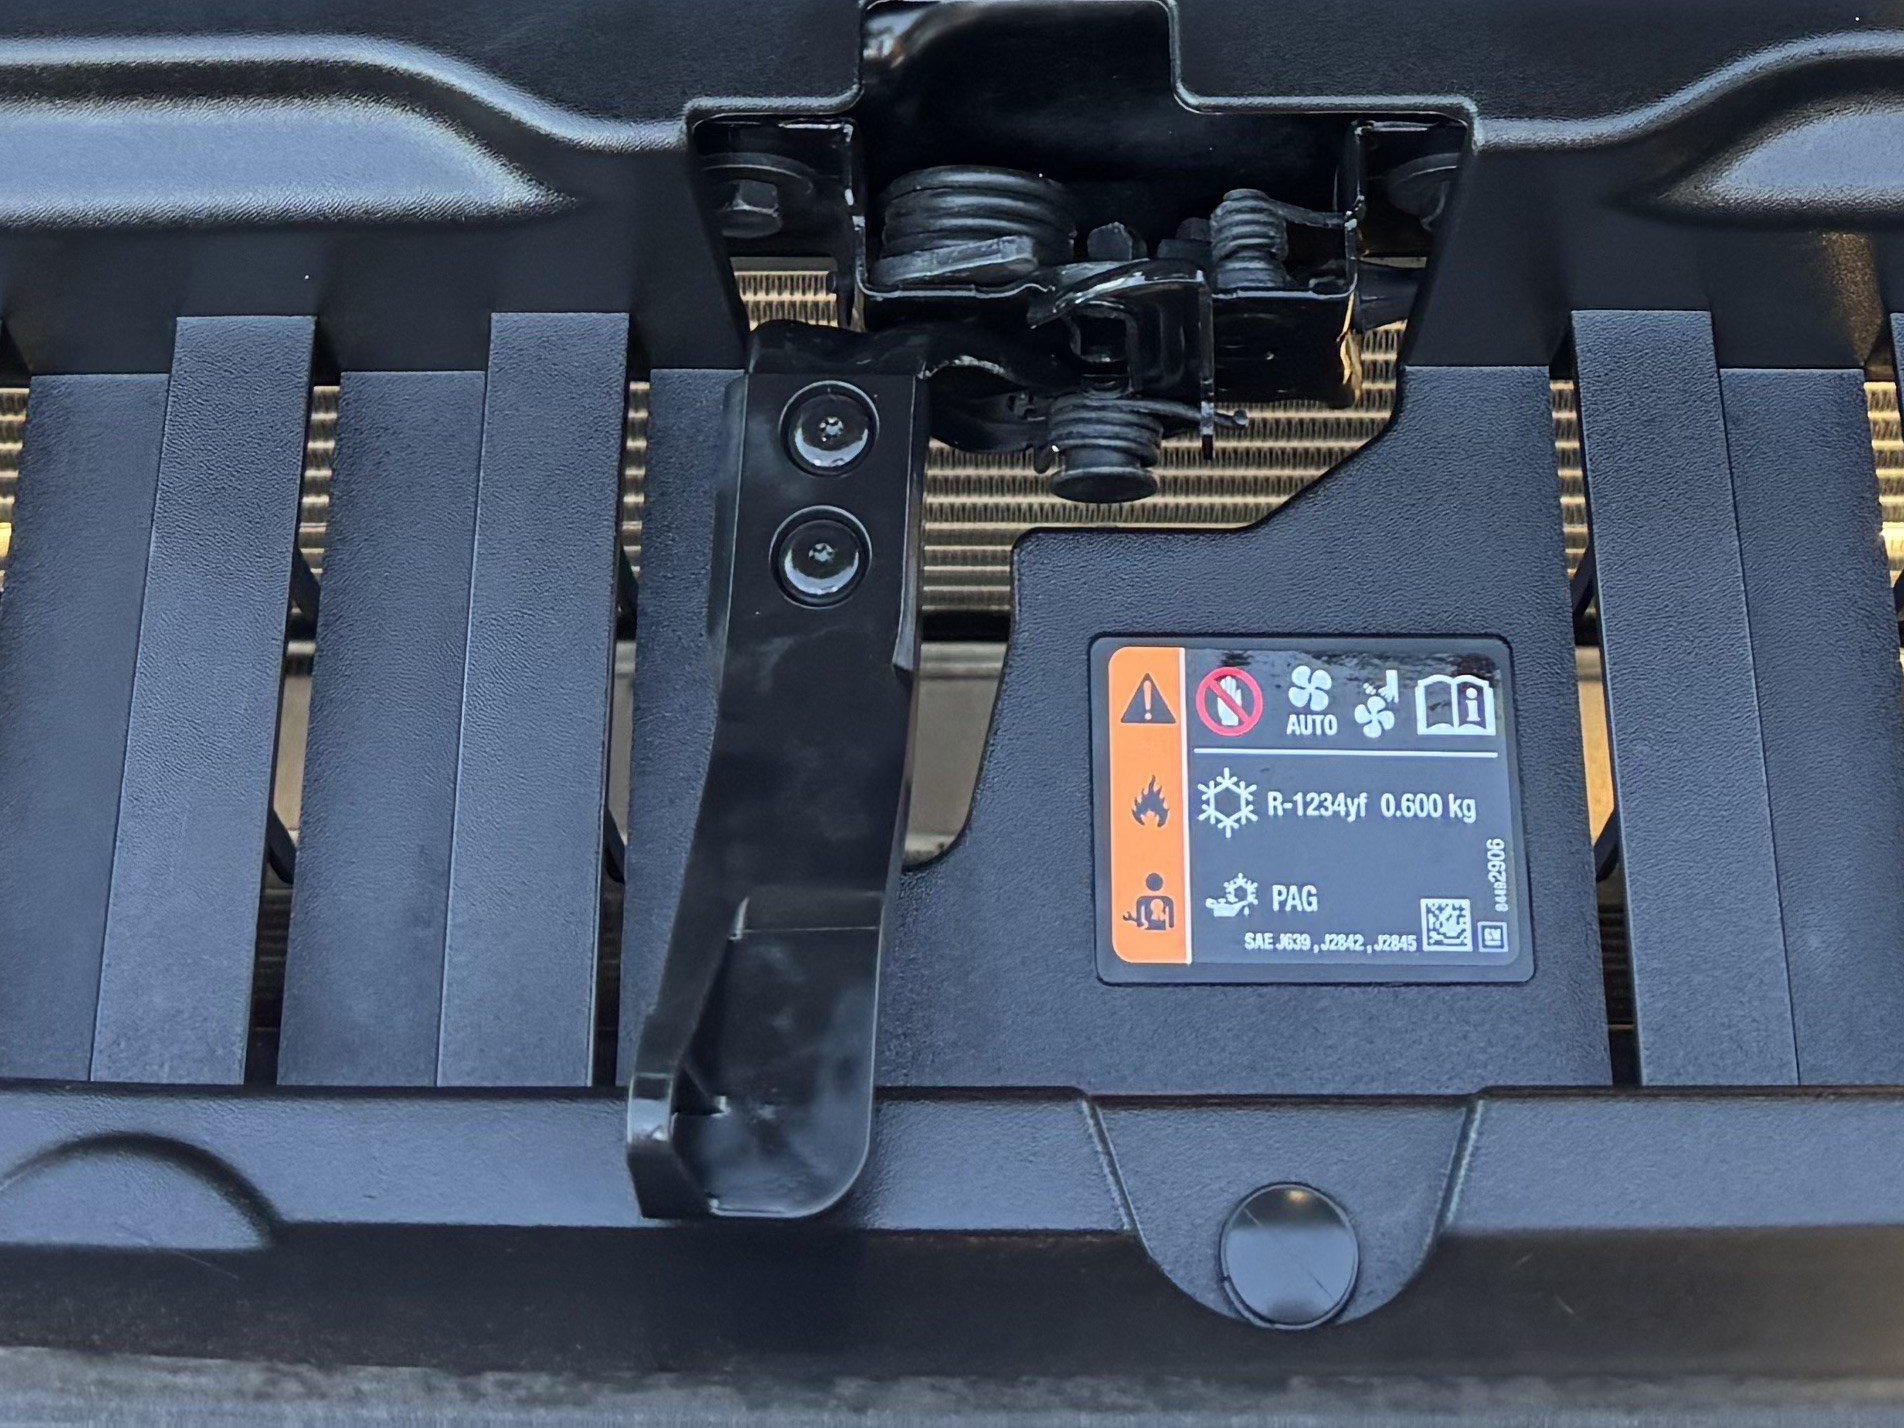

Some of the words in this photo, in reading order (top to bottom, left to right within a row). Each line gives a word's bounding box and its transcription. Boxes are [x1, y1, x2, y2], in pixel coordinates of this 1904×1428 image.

[1287, 714, 1338, 737] AUTO
[1267, 790, 1368, 823] R-1234yf
[1381, 792, 1443, 818] 0.600
[1449, 793, 1477, 824] kg
[1272, 884, 1318, 912] PAG
[1245, 931, 1274, 952] SAE
[1374, 934, 1418, 953] J2845
